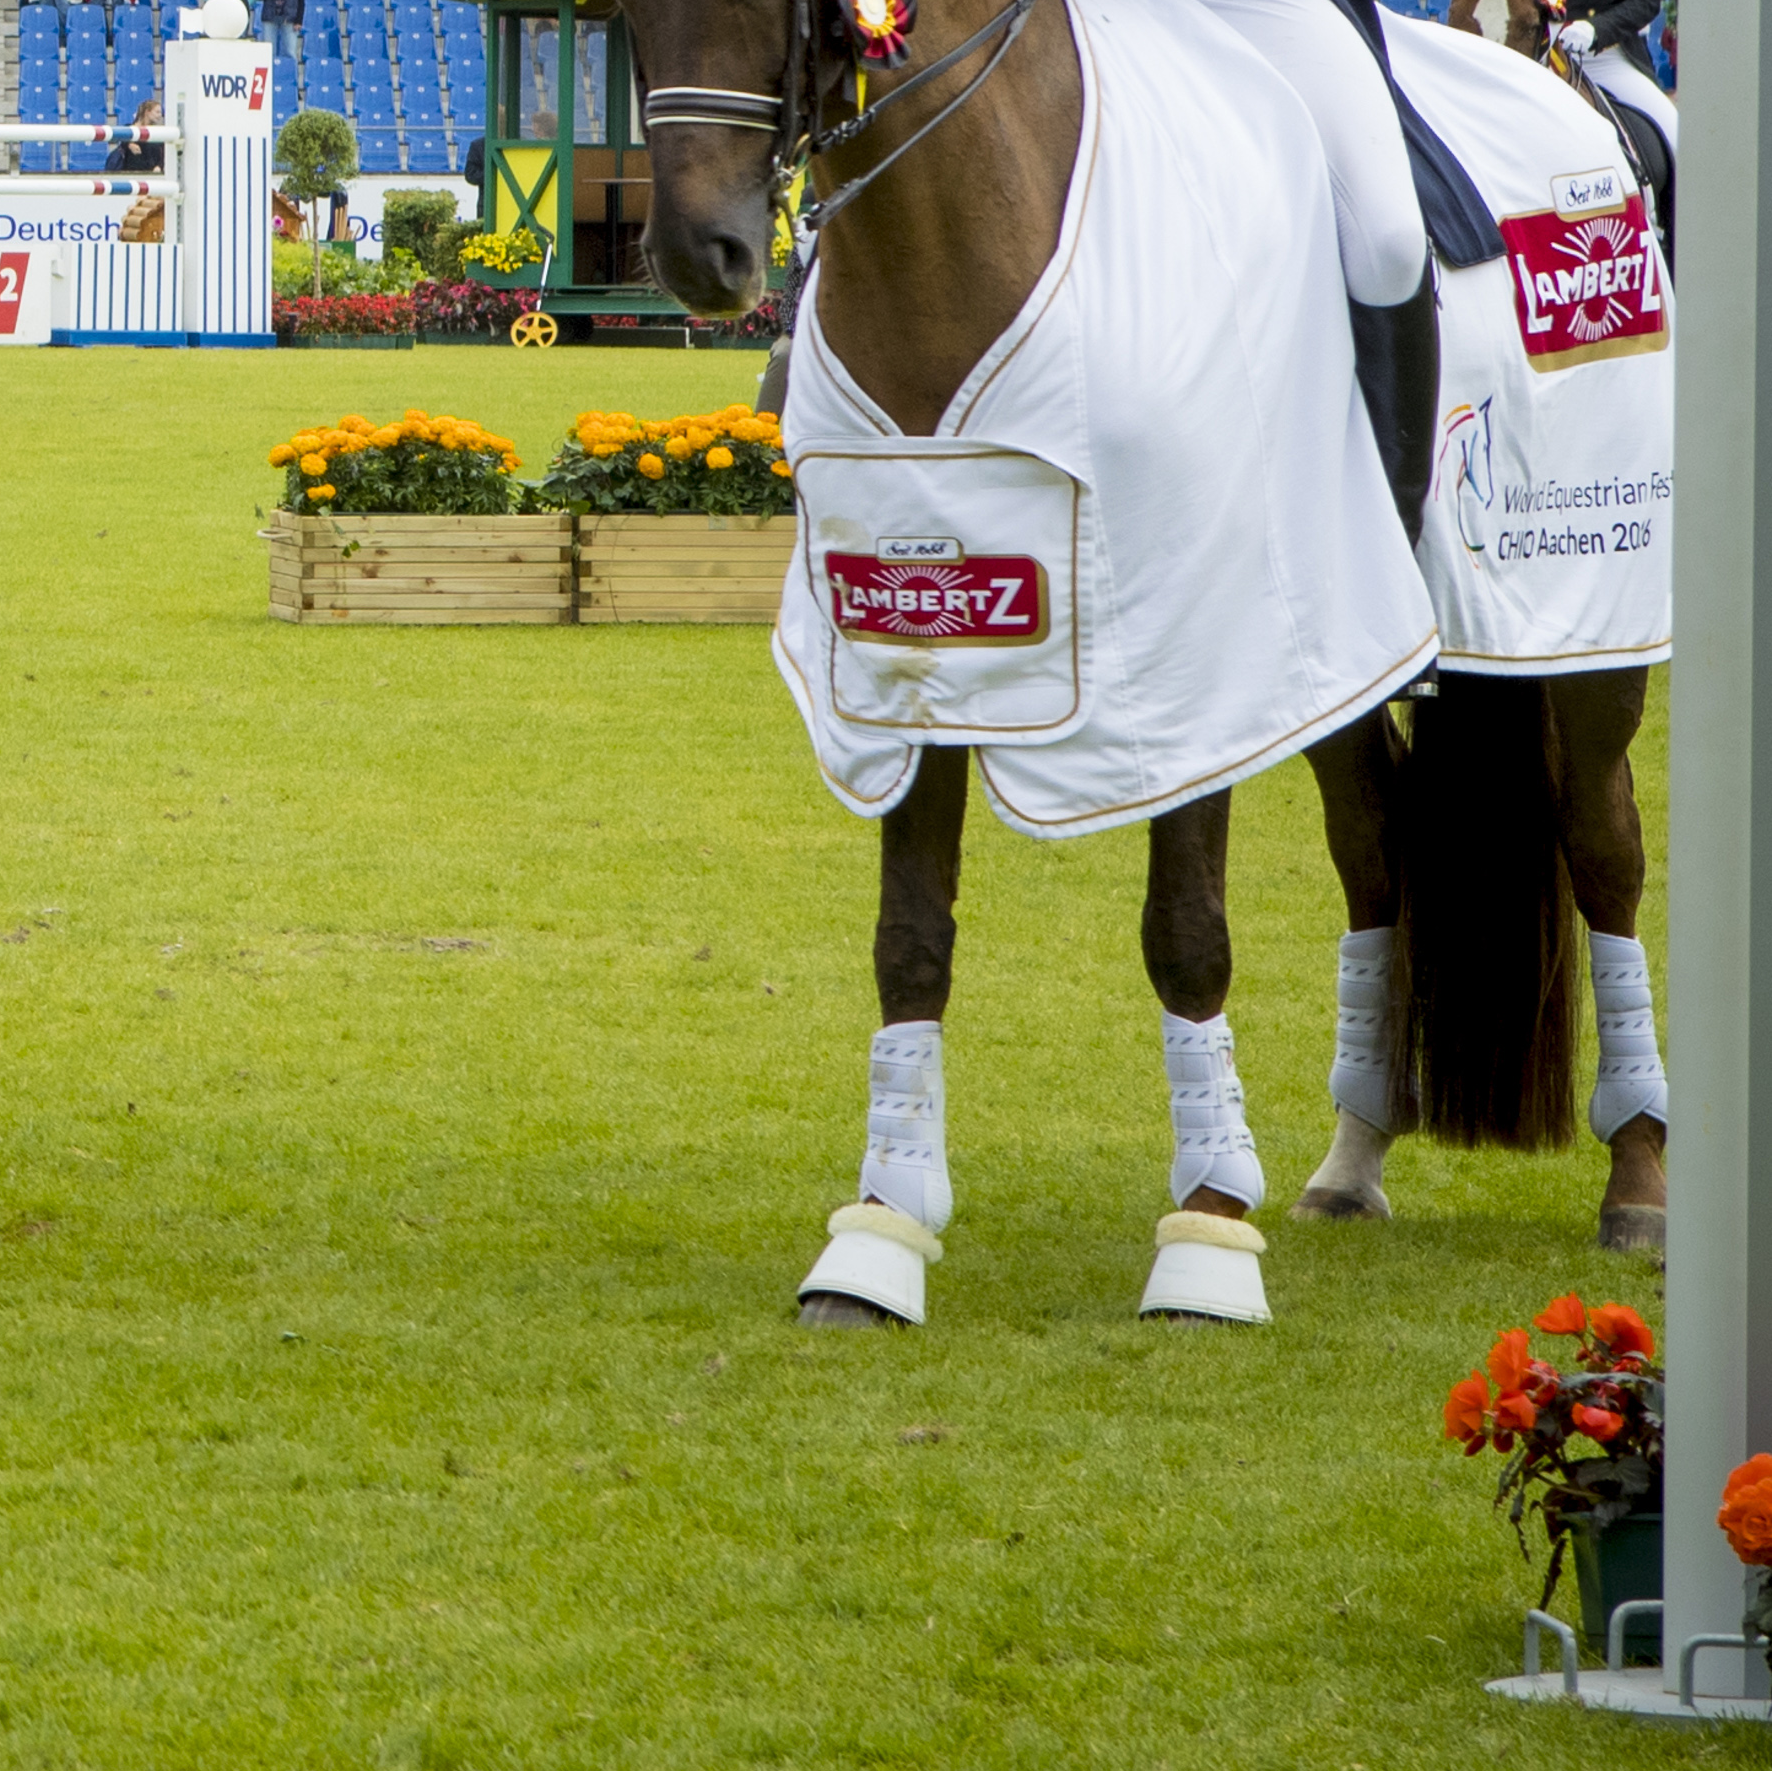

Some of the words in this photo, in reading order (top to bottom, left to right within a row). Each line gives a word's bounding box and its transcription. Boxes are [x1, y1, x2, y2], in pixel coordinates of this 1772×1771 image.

[201, 75, 247, 99] WDR
[253, 75, 264, 95] 2
[1566, 180, 1591, 207] Seit
[1593, 176, 1613, 199] 1688
[0, 268, 18, 302] 2
[1515, 229, 1661, 334] LAMBERTZ
[1504, 481, 1546, 514] World
[1546, 476, 1647, 515] Equestrian
[886, 542, 912, 556] Seit
[1498, 530, 1535, 560] CHIO
[1537, 525, 1605, 557] Aachen
[831, 573, 1031, 625] LAMBERTZ
